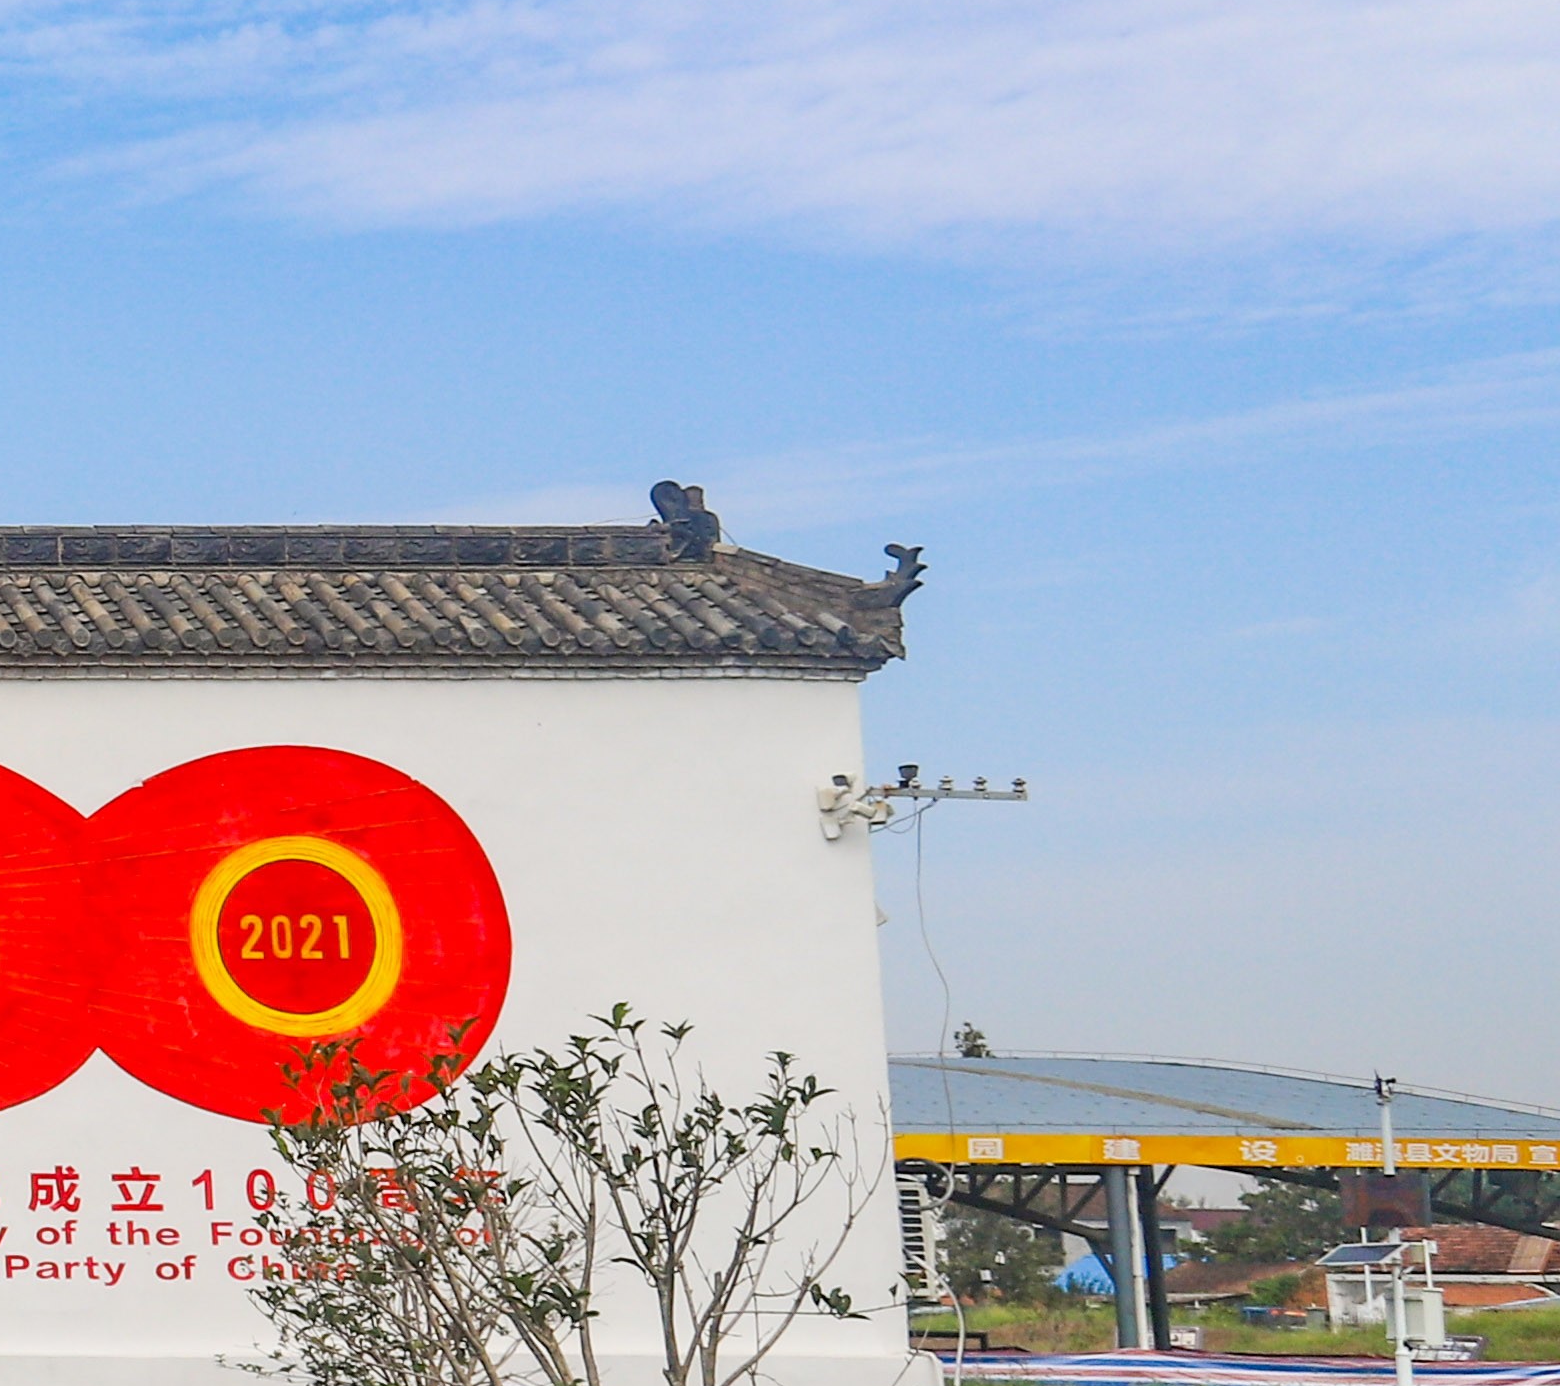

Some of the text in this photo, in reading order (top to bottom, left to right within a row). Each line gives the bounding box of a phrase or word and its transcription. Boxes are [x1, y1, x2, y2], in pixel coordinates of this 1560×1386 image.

[240, 915, 350, 959] 2021
[1529, 1144, 1558, 1165] 宣
[36, 1219, 78, 1245] of
[107, 1220, 181, 1246] the
[5, 1254, 126, 1286] Party
[155, 1254, 196, 1280] of
